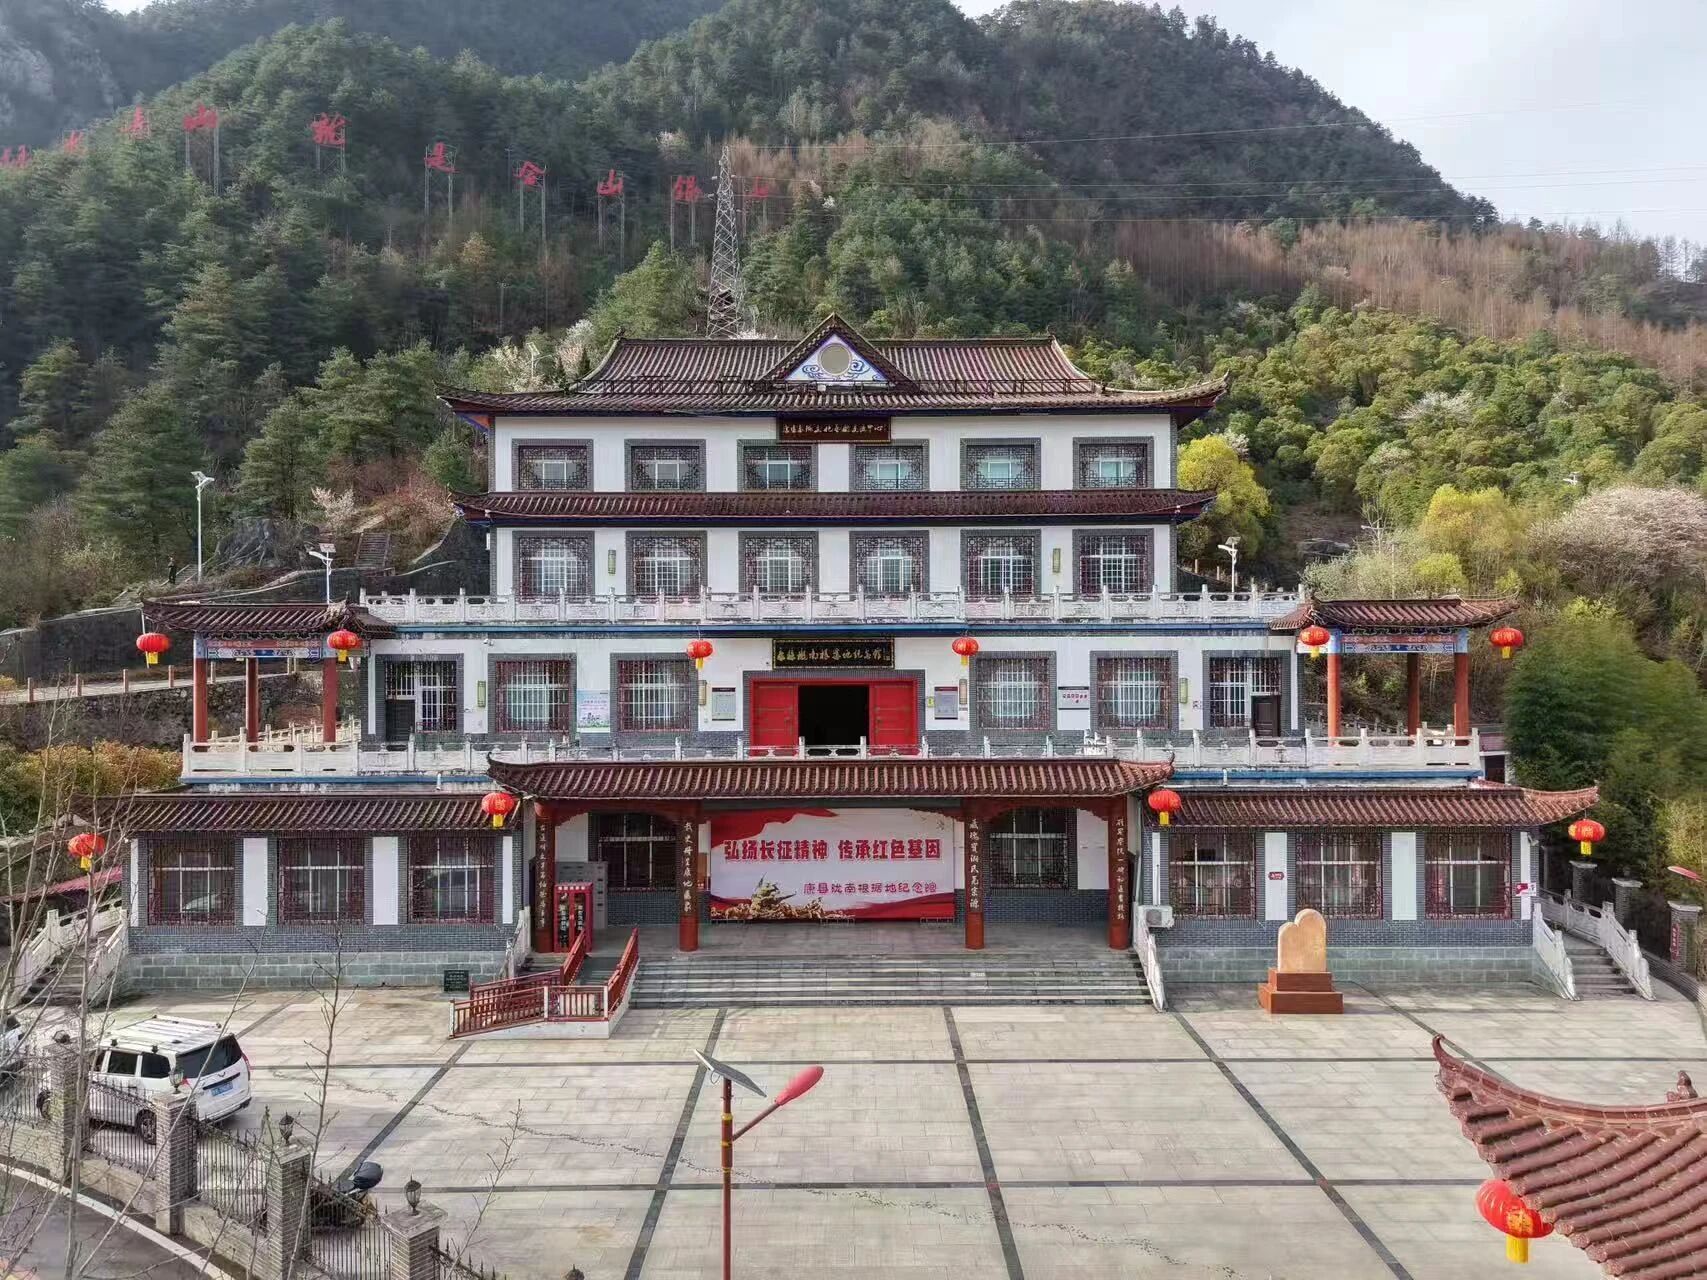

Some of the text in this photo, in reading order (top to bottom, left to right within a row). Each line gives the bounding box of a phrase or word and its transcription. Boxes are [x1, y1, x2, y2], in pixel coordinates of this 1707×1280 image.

[724, 838, 941, 860] 弘扬长征精神 传承红色基因
[803, 881, 938, 895] 康县陇南根据地纪念馆
